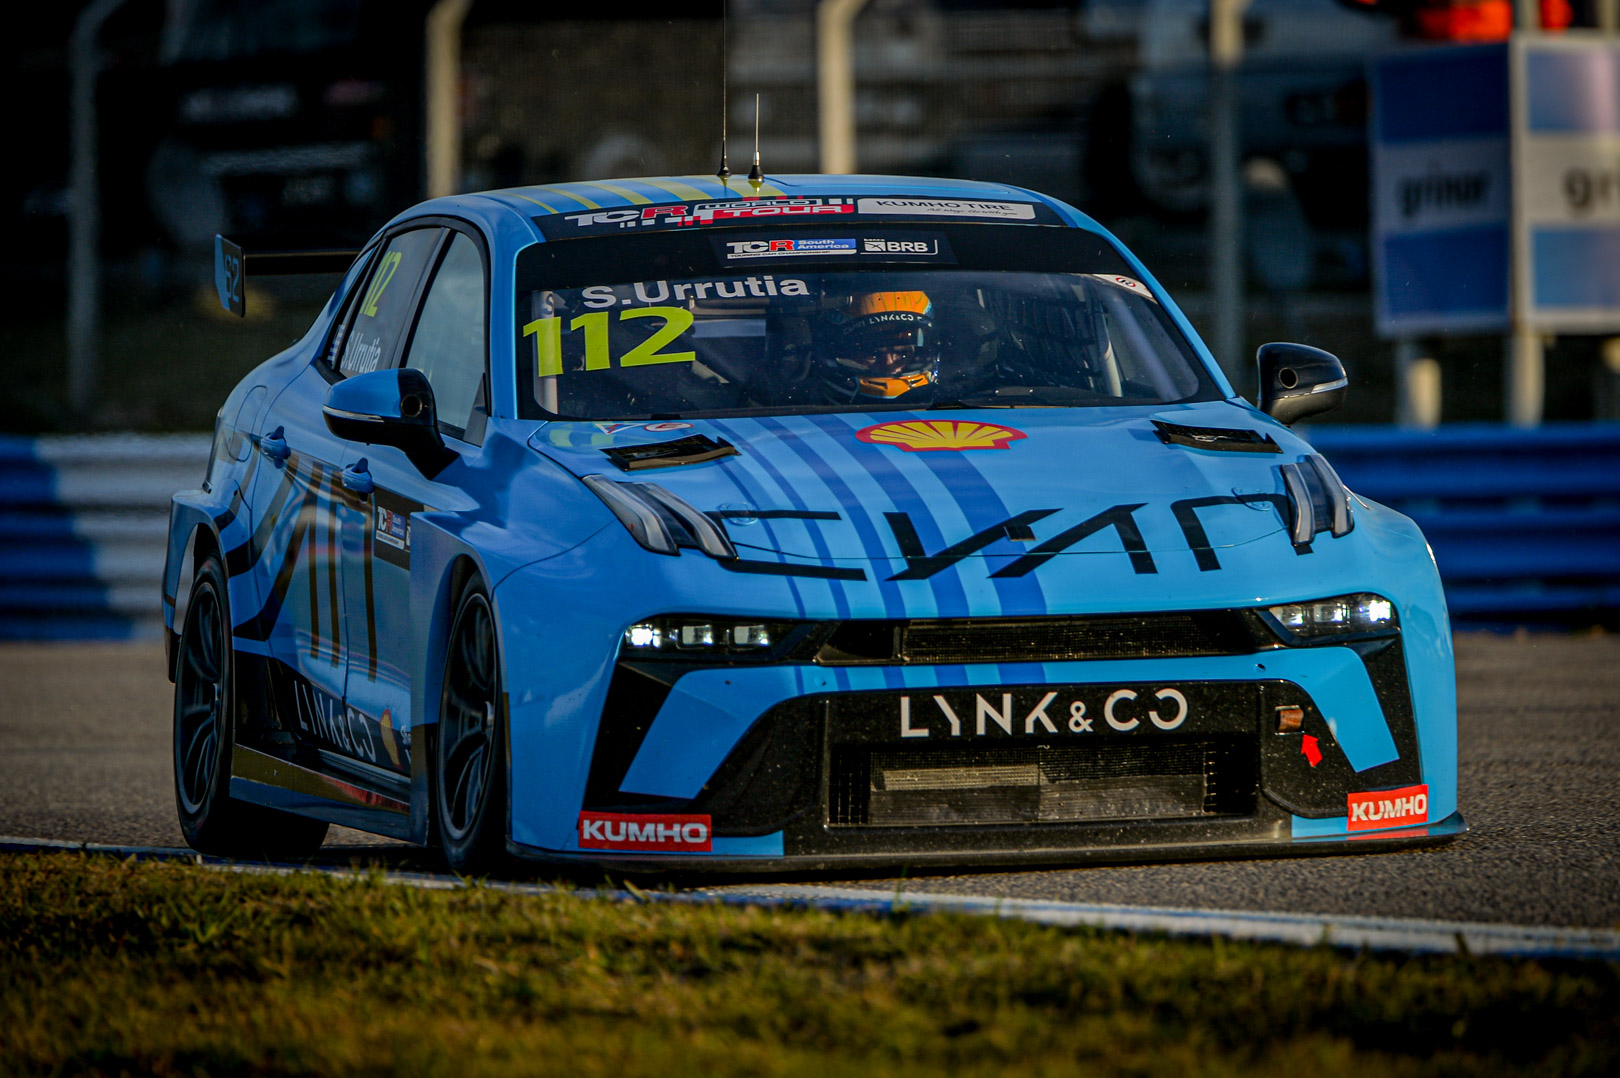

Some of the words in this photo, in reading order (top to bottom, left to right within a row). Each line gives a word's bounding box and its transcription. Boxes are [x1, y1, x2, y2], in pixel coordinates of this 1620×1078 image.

[565, 205, 689, 227] TCR
[723, 205, 843, 217] TOUR
[876, 200, 961, 209] KUMHO
[963, 202, 1014, 211] TIRE
[726, 239, 796, 254] TCR
[797, 243, 850, 251] America
[886, 240, 929, 253] BRB
[359, 250, 403, 318] 112
[582, 275, 810, 308] S.Urrutia
[522, 306, 696, 377] 112
[1350, 793, 1428, 822] KUMHO
[582, 819, 709, 844] KUMHO
